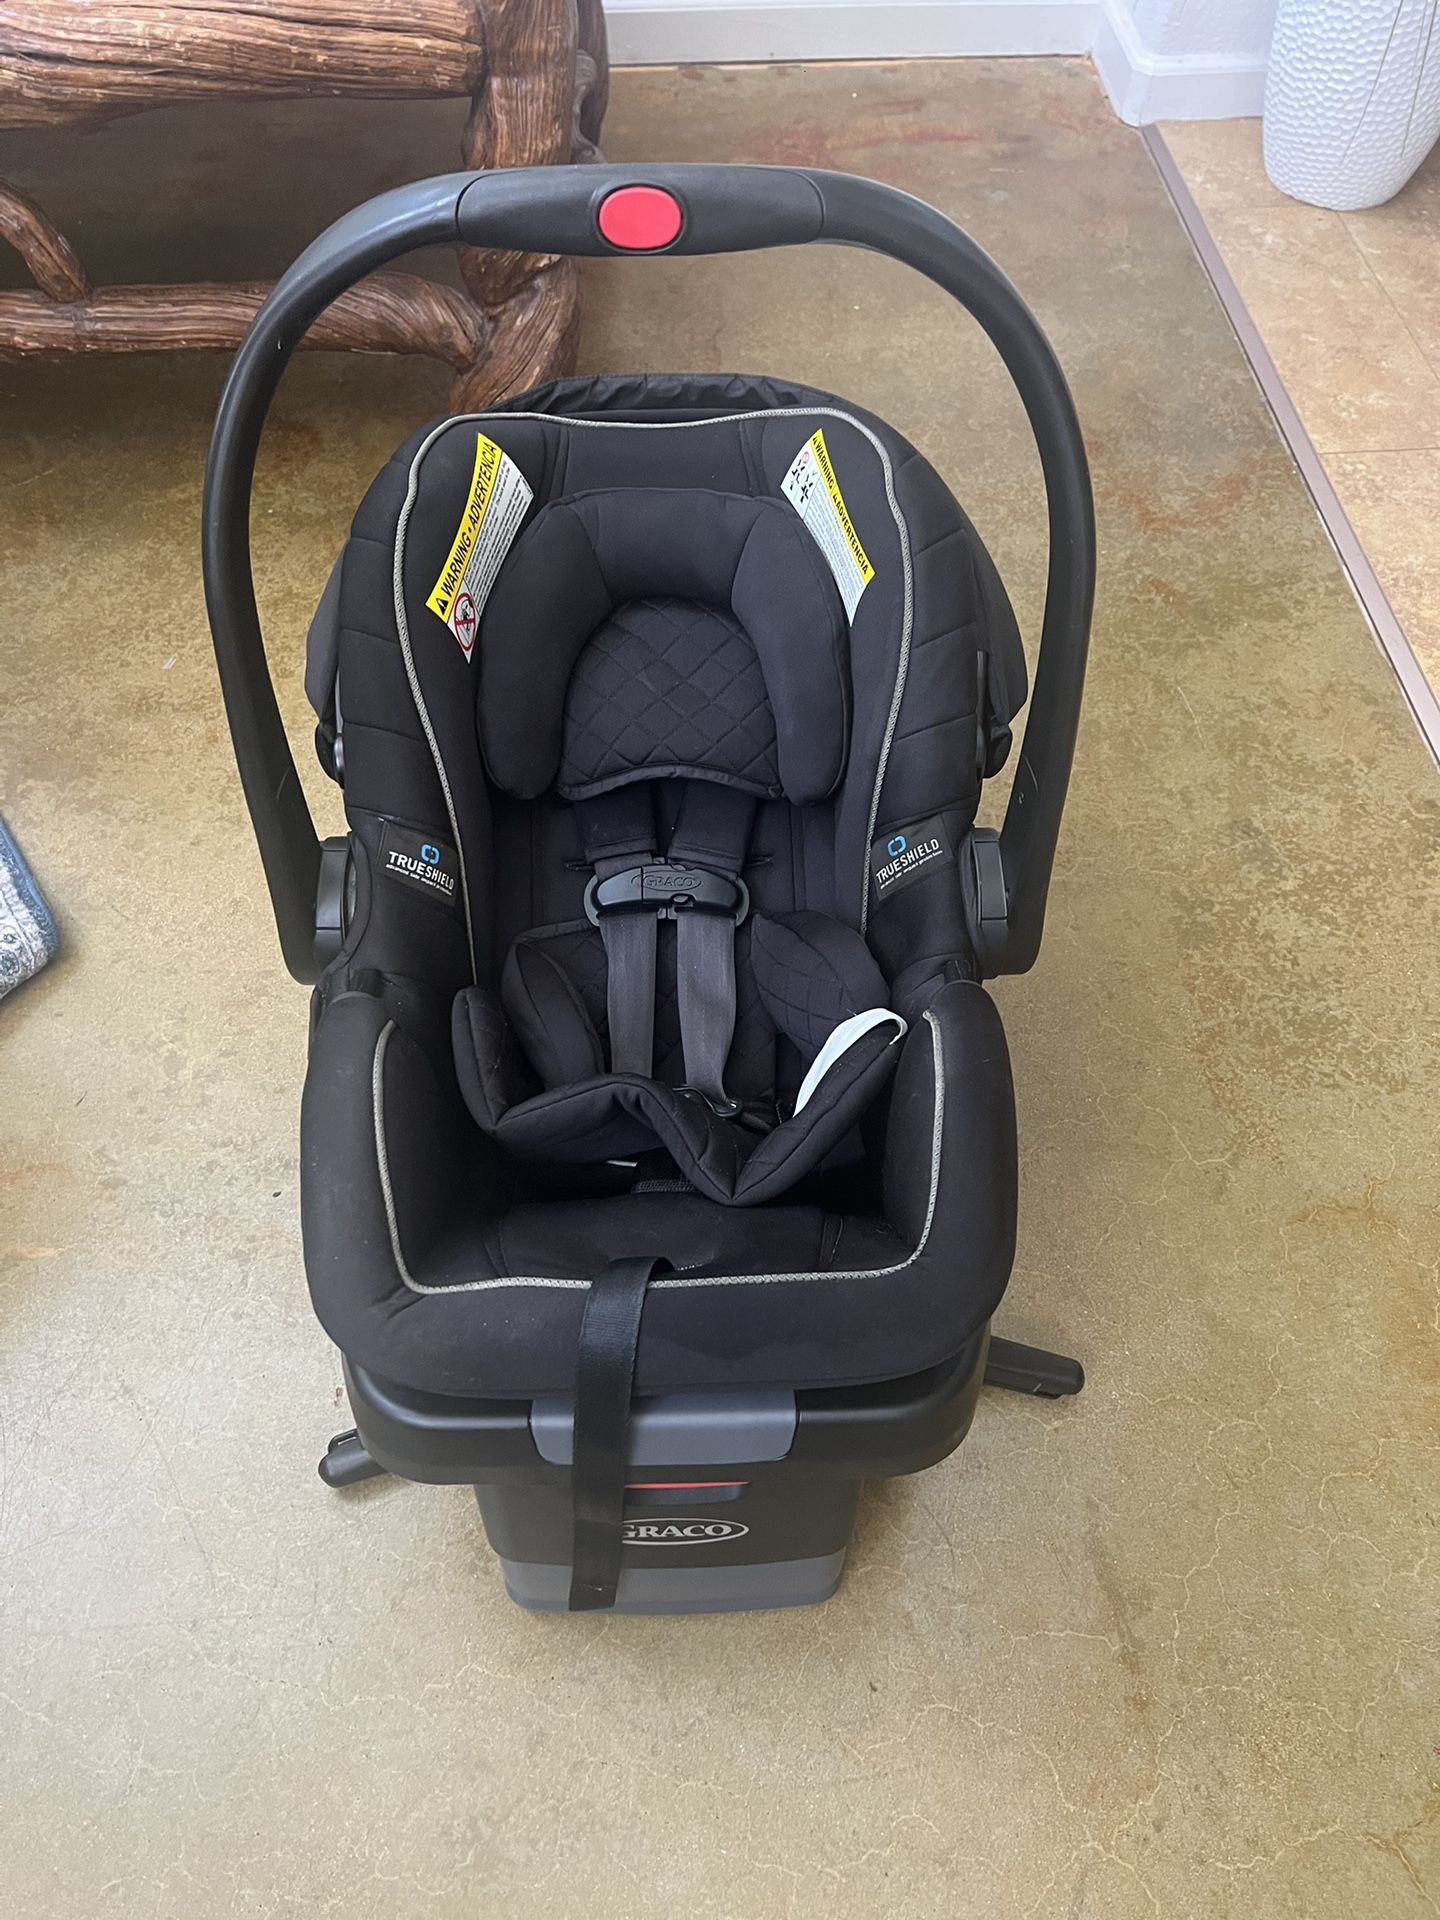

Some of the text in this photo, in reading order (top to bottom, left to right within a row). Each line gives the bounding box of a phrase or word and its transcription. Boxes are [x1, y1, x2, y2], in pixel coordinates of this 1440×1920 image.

[440, 442, 497, 598] WARNING ADVERTENCIA
[815, 441, 868, 575] WARNING ADVERTENCIA
[388, 851, 454, 890] TRUESHIELD
[876, 838, 939, 883] TRUESHIELD
